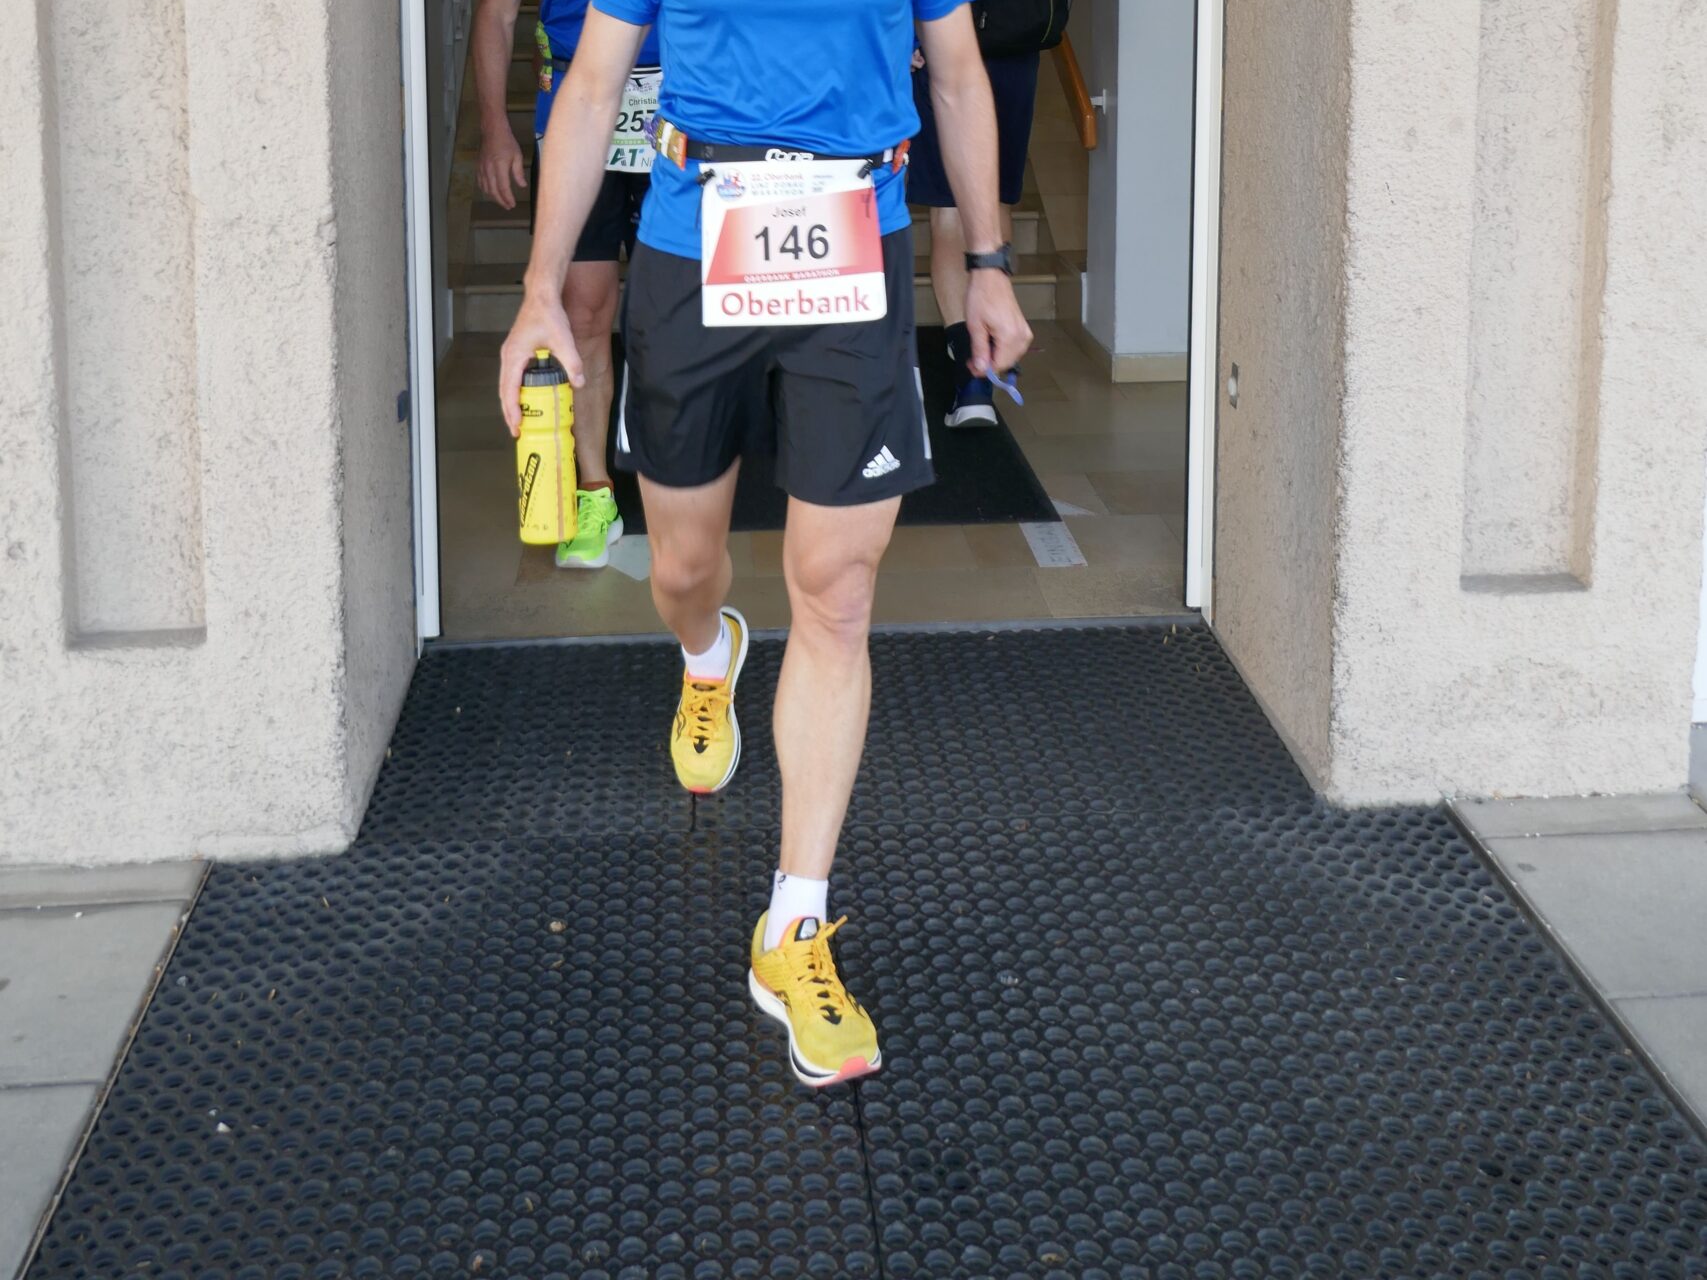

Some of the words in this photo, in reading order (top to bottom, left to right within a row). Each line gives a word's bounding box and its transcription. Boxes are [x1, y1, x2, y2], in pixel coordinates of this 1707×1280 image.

[616, 109, 656, 132] 25
[755, 224, 829, 261] 146
[721, 286, 871, 317] Oberbank
